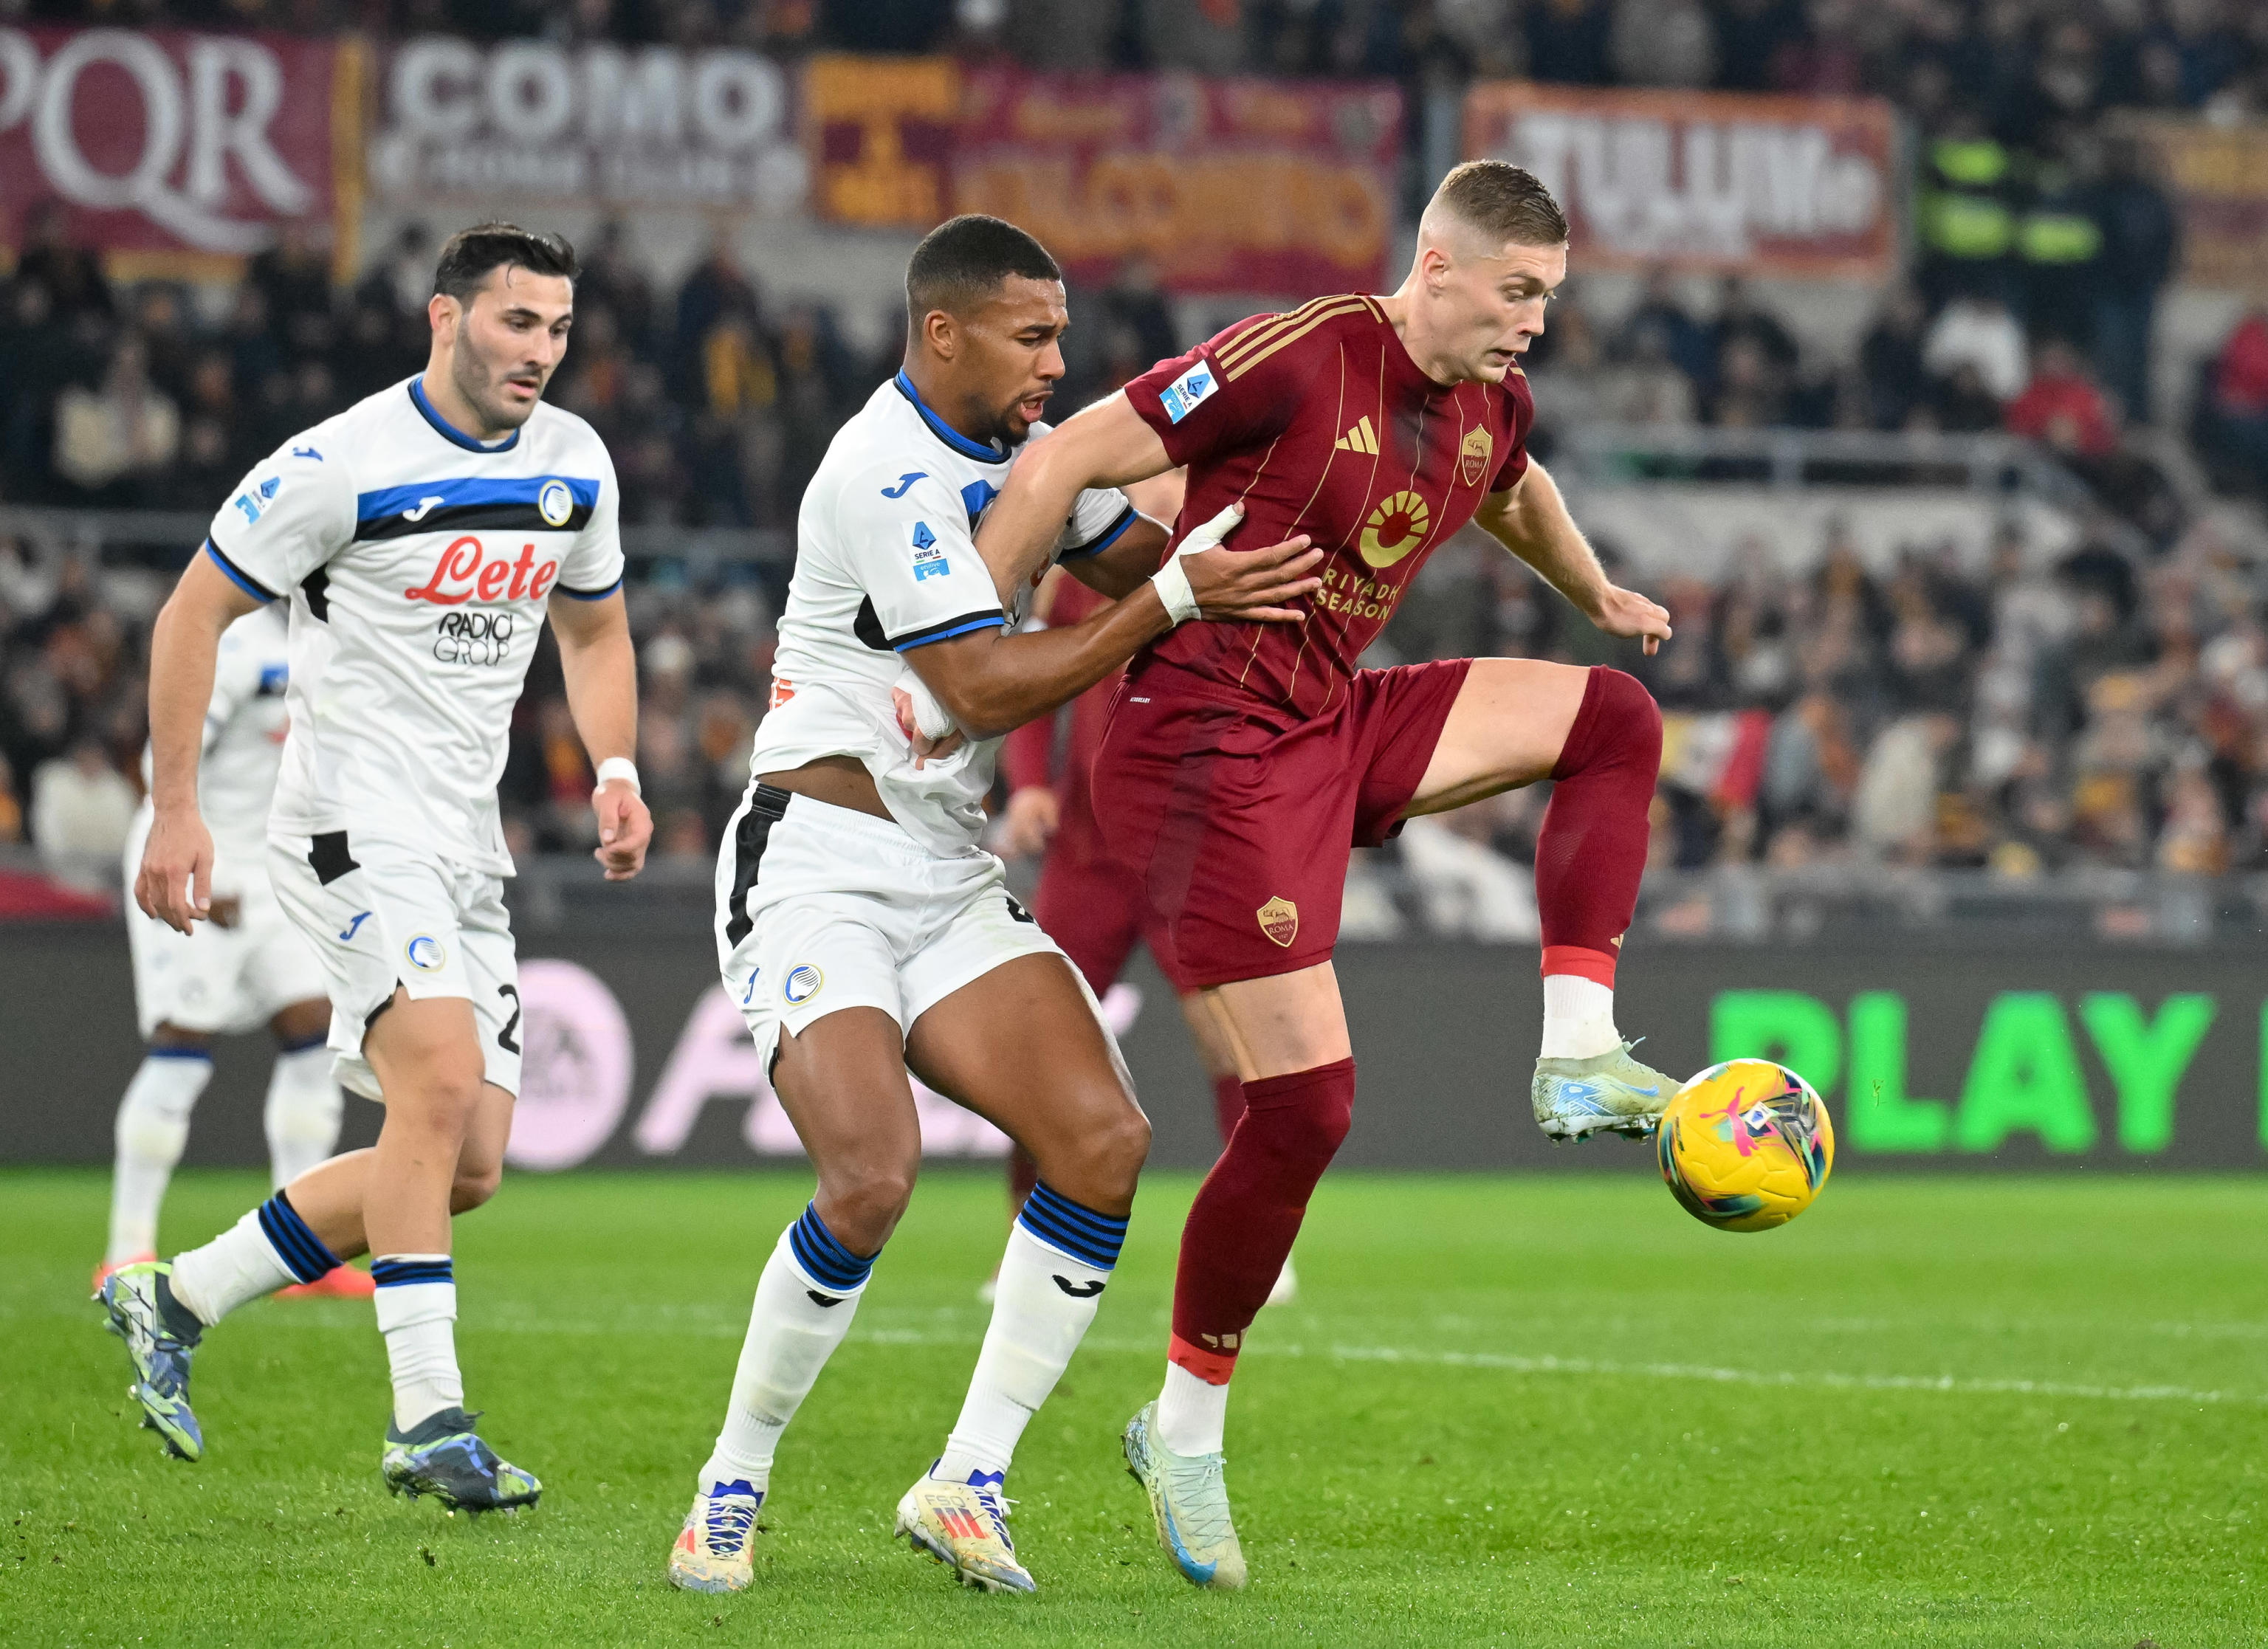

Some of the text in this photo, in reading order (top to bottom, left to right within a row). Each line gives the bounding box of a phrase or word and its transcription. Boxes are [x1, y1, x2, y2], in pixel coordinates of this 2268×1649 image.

[393, 34, 786, 146] COMO
[1177, 384, 1191, 402] SERIE
[1465, 459, 1483, 469] ROMA
[404, 535, 557, 605] Lete
[915, 550, 934, 560] SERIE
[1322, 568, 1401, 602] RIYADH
[1316, 588, 1392, 620] SEASON
[439, 612, 514, 641] RADICI
[433, 636, 509, 667] GROUP
[1268, 923, 1294, 934] ROMA
[1708, 988, 2216, 1154] PLAY
[924, 1494, 966, 1508] F50
